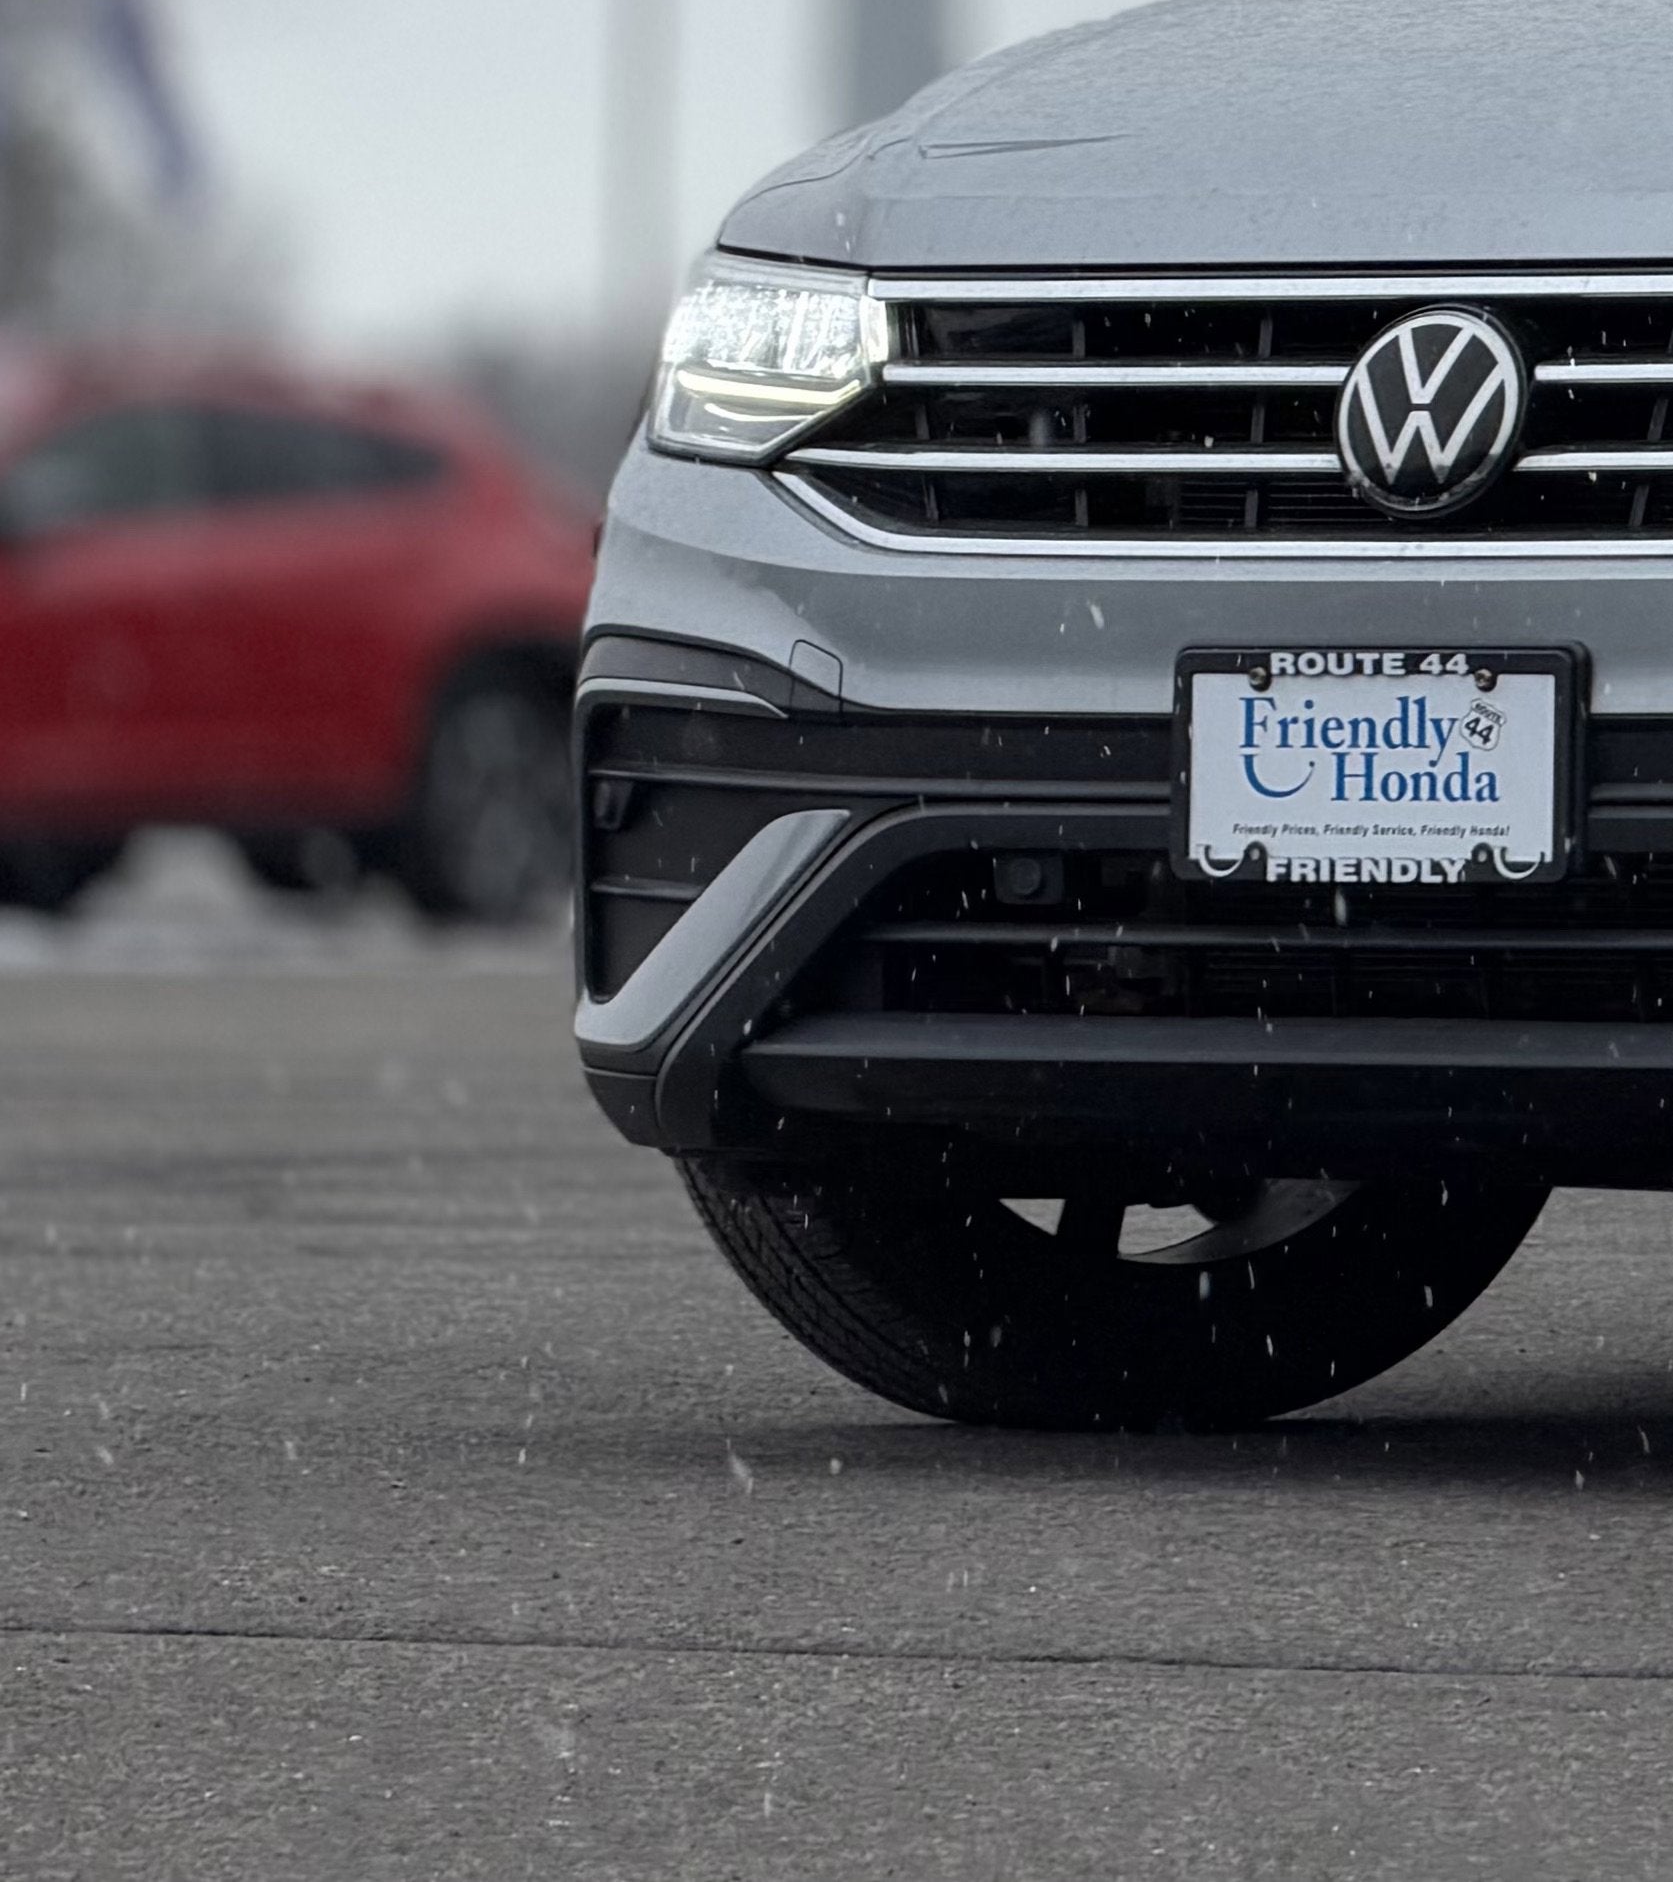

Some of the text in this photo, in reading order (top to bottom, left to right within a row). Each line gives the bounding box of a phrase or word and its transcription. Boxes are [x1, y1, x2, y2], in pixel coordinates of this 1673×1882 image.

[1269, 652, 1469, 676] ROUTE 44
[1239, 696, 1458, 768] Friendly
[1464, 717, 1494, 745] 44
[1331, 751, 1500, 802] Honda
[1232, 823, 1278, 838] Friendly
[1323, 823, 1369, 838] Friendly
[1420, 824, 1466, 839] Friendly
[1266, 857, 1466, 883] FRIENDLY
